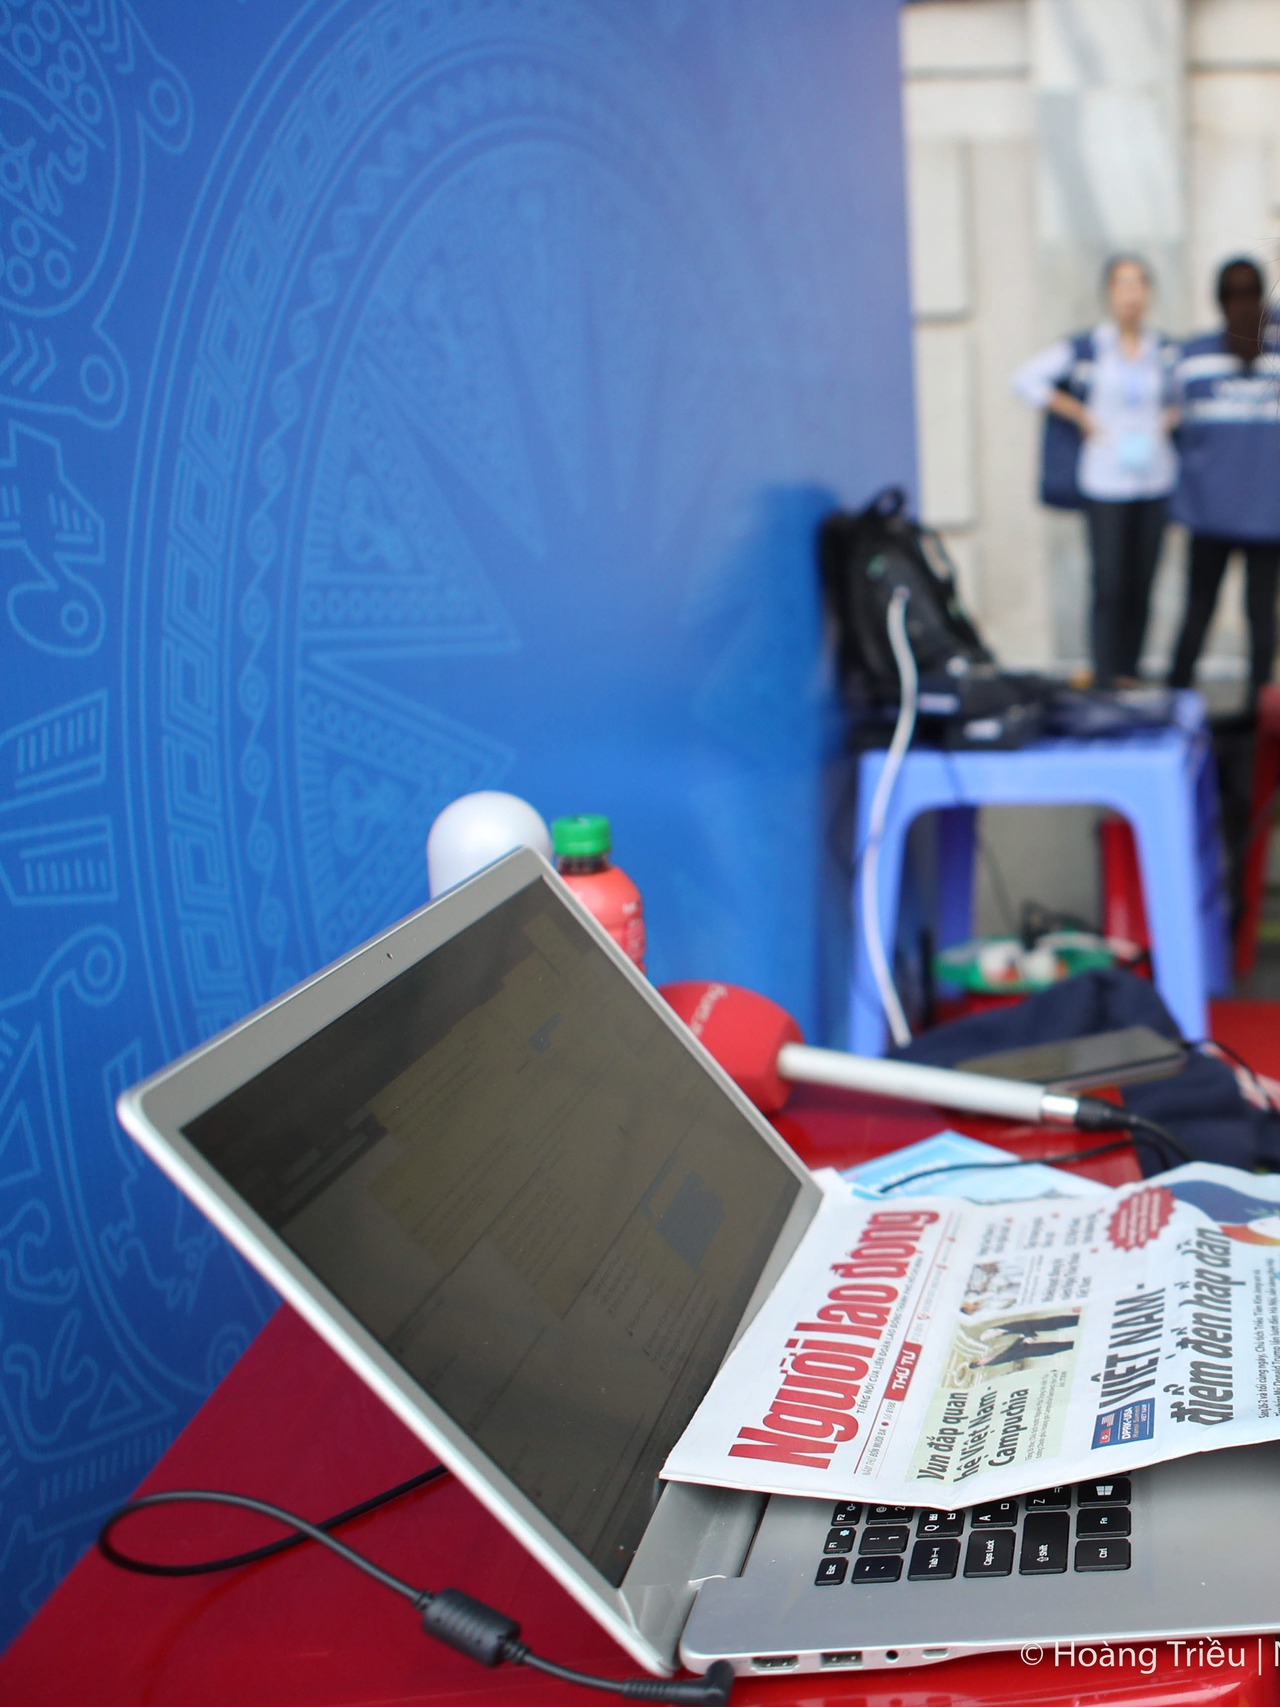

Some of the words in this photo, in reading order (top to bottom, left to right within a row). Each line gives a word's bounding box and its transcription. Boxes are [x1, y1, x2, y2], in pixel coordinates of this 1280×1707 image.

[828, 1209, 940, 1279] động
[1176, 1227, 1231, 1268] dẫn
[1174, 1268, 1246, 1313] hấp
[794, 1284, 900, 1340] lao
[1108, 1287, 1166, 1349] NAM
[1171, 1312, 1233, 1359] đến
[892, 1369, 911, 1390] THỨ
[1090, 1348, 1174, 1409] VIỆT
[1163, 1360, 1234, 1426] điểm
[728, 1338, 877, 1470] Người
[942, 1392, 969, 1424] quan
[968, 1391, 998, 1429] Nam
[1121, 1406, 1132, 1439] DPRK-USA
[926, 1428, 964, 1452] đắp
[958, 1424, 995, 1461] Việt
[988, 1388, 1029, 1466] Campuchia
[917, 1454, 951, 1480] Vun
[953, 1454, 988, 1482] hệ
[1099, 1546, 1108, 1558] Ctrl
